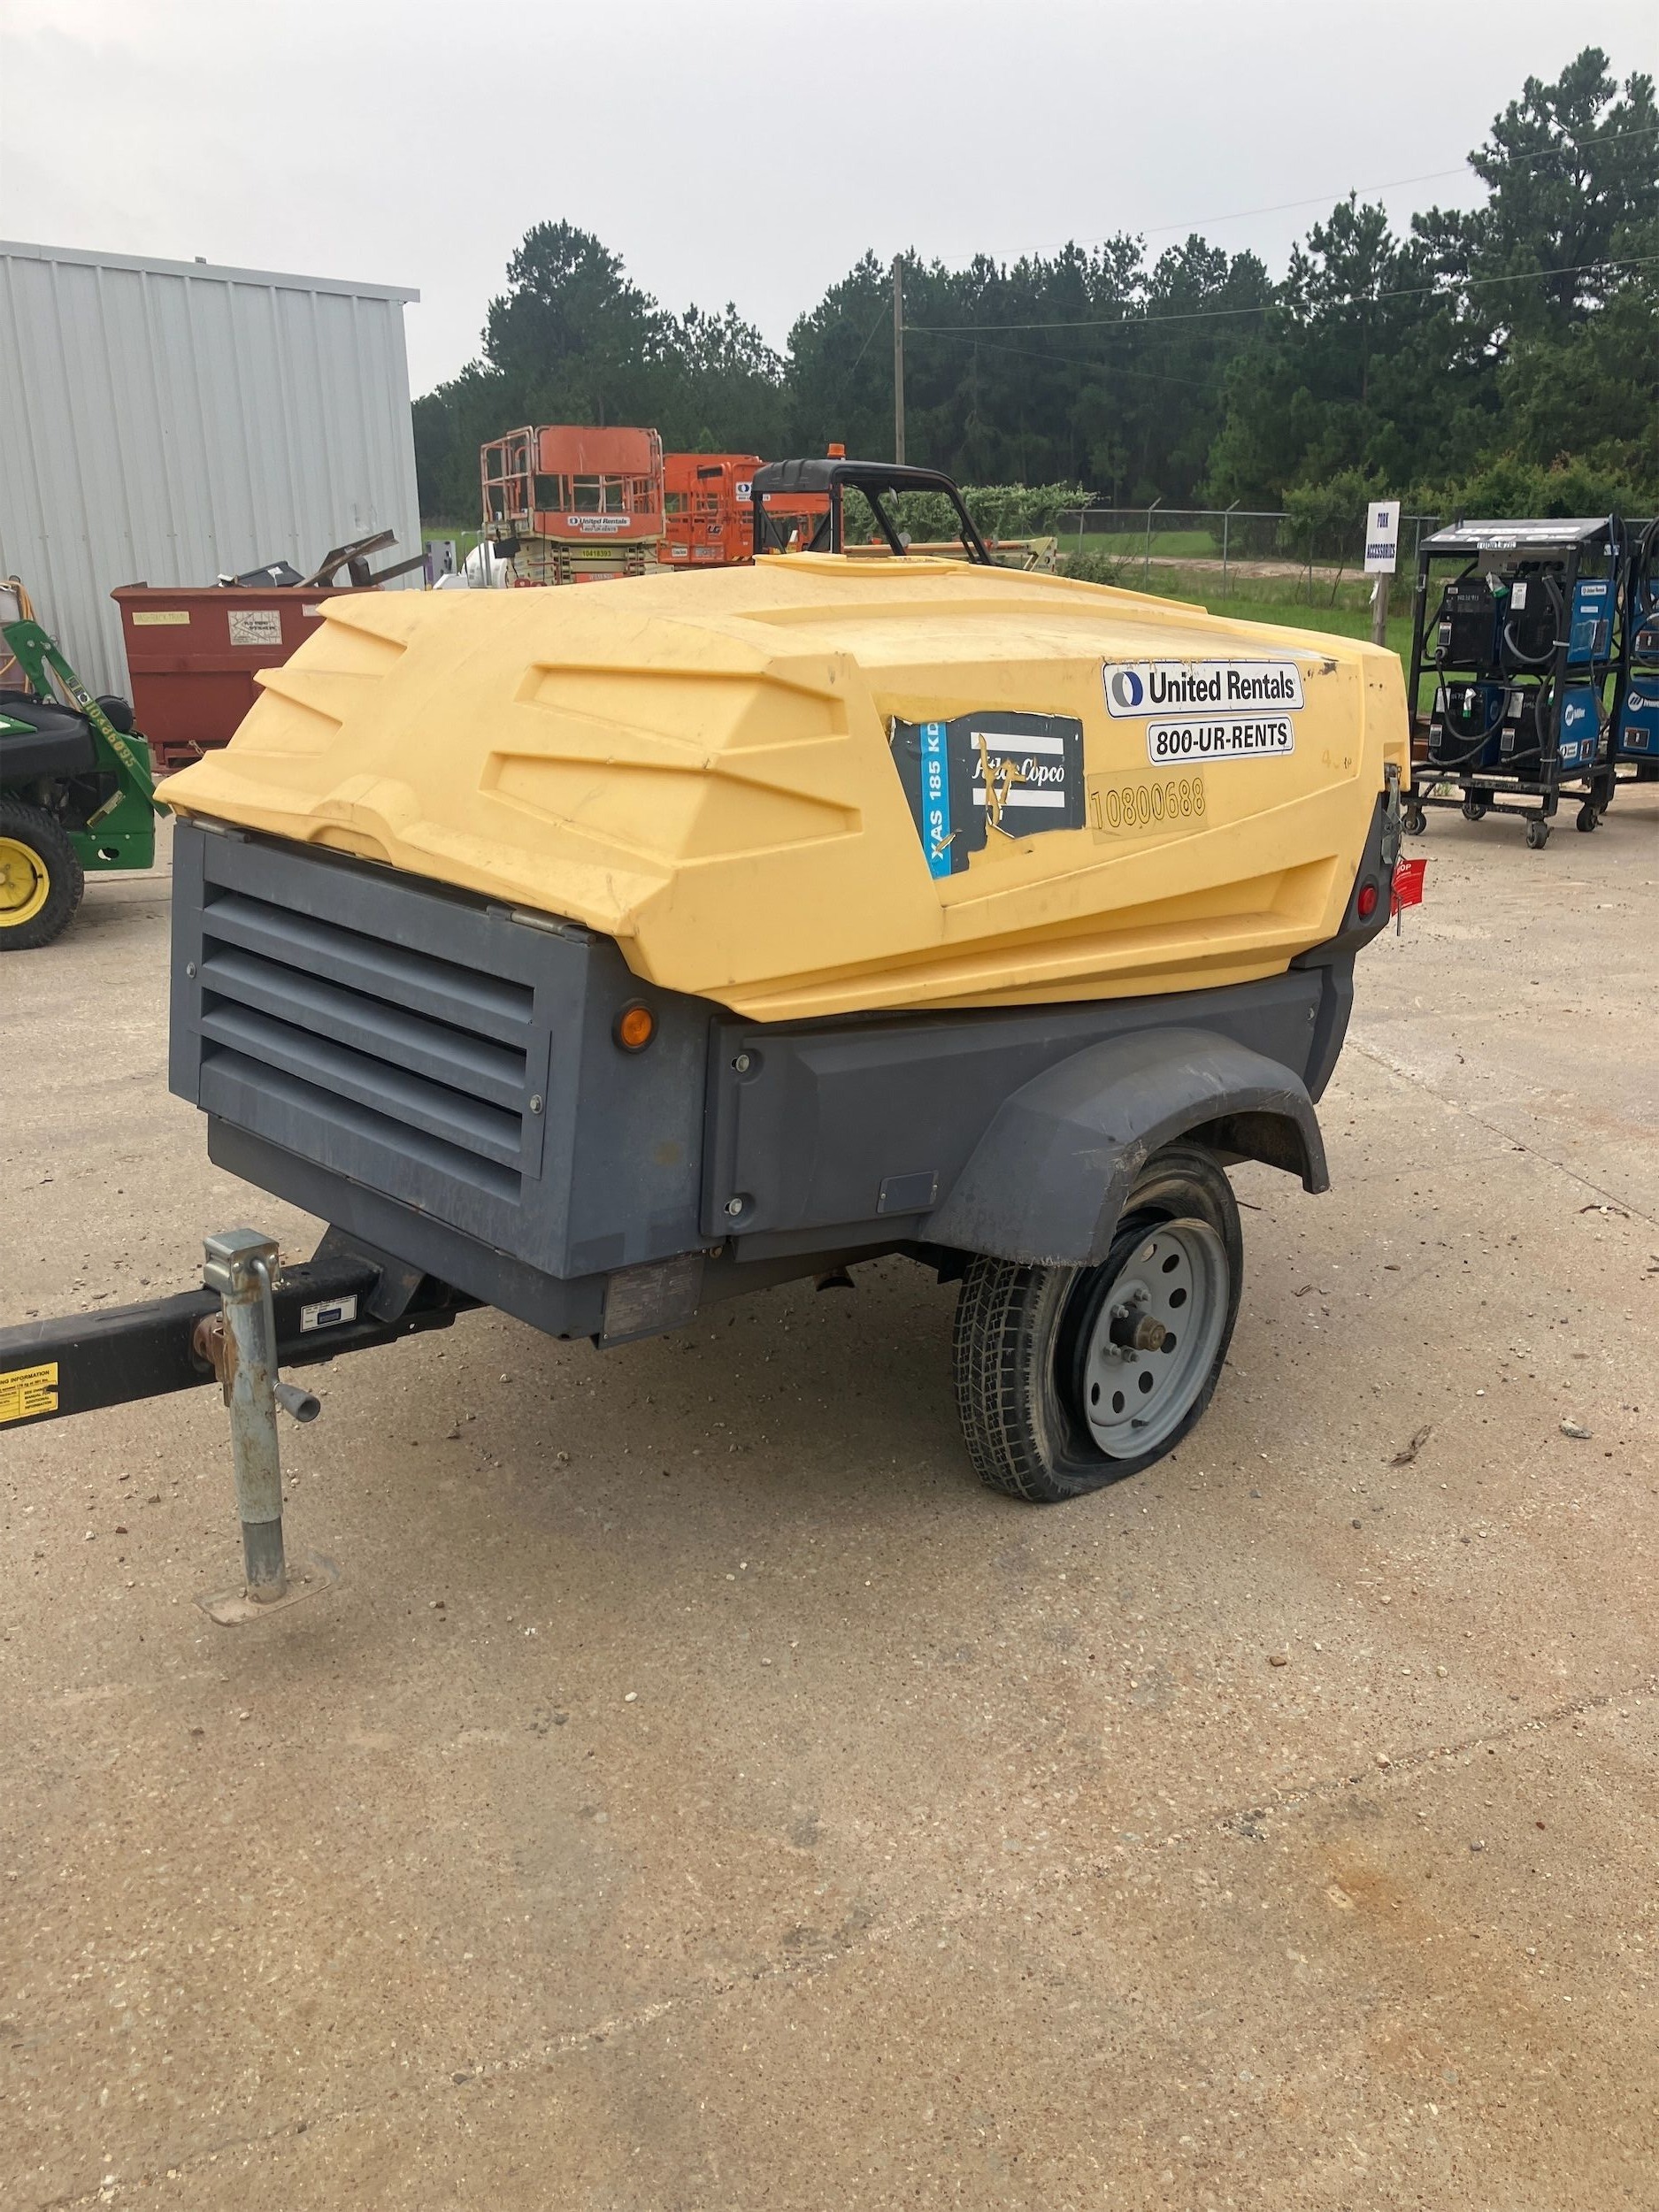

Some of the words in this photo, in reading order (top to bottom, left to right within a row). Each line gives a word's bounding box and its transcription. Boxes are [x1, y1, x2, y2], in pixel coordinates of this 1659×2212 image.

[1366, 543, 1395, 559] ACCESSORIES
[1150, 671, 1221, 703] United
[1226, 670, 1295, 701] Rentals
[927, 722, 940, 753] KD
[1156, 722, 1287, 757] 800-UR-RENTS
[929, 760, 941, 801] 185
[1021, 757, 1064, 787] Copco
[1090, 777, 1206, 829] 10800688
[930, 810, 944, 861] XAS
[11, 1371, 50, 1383] INFORMATION
